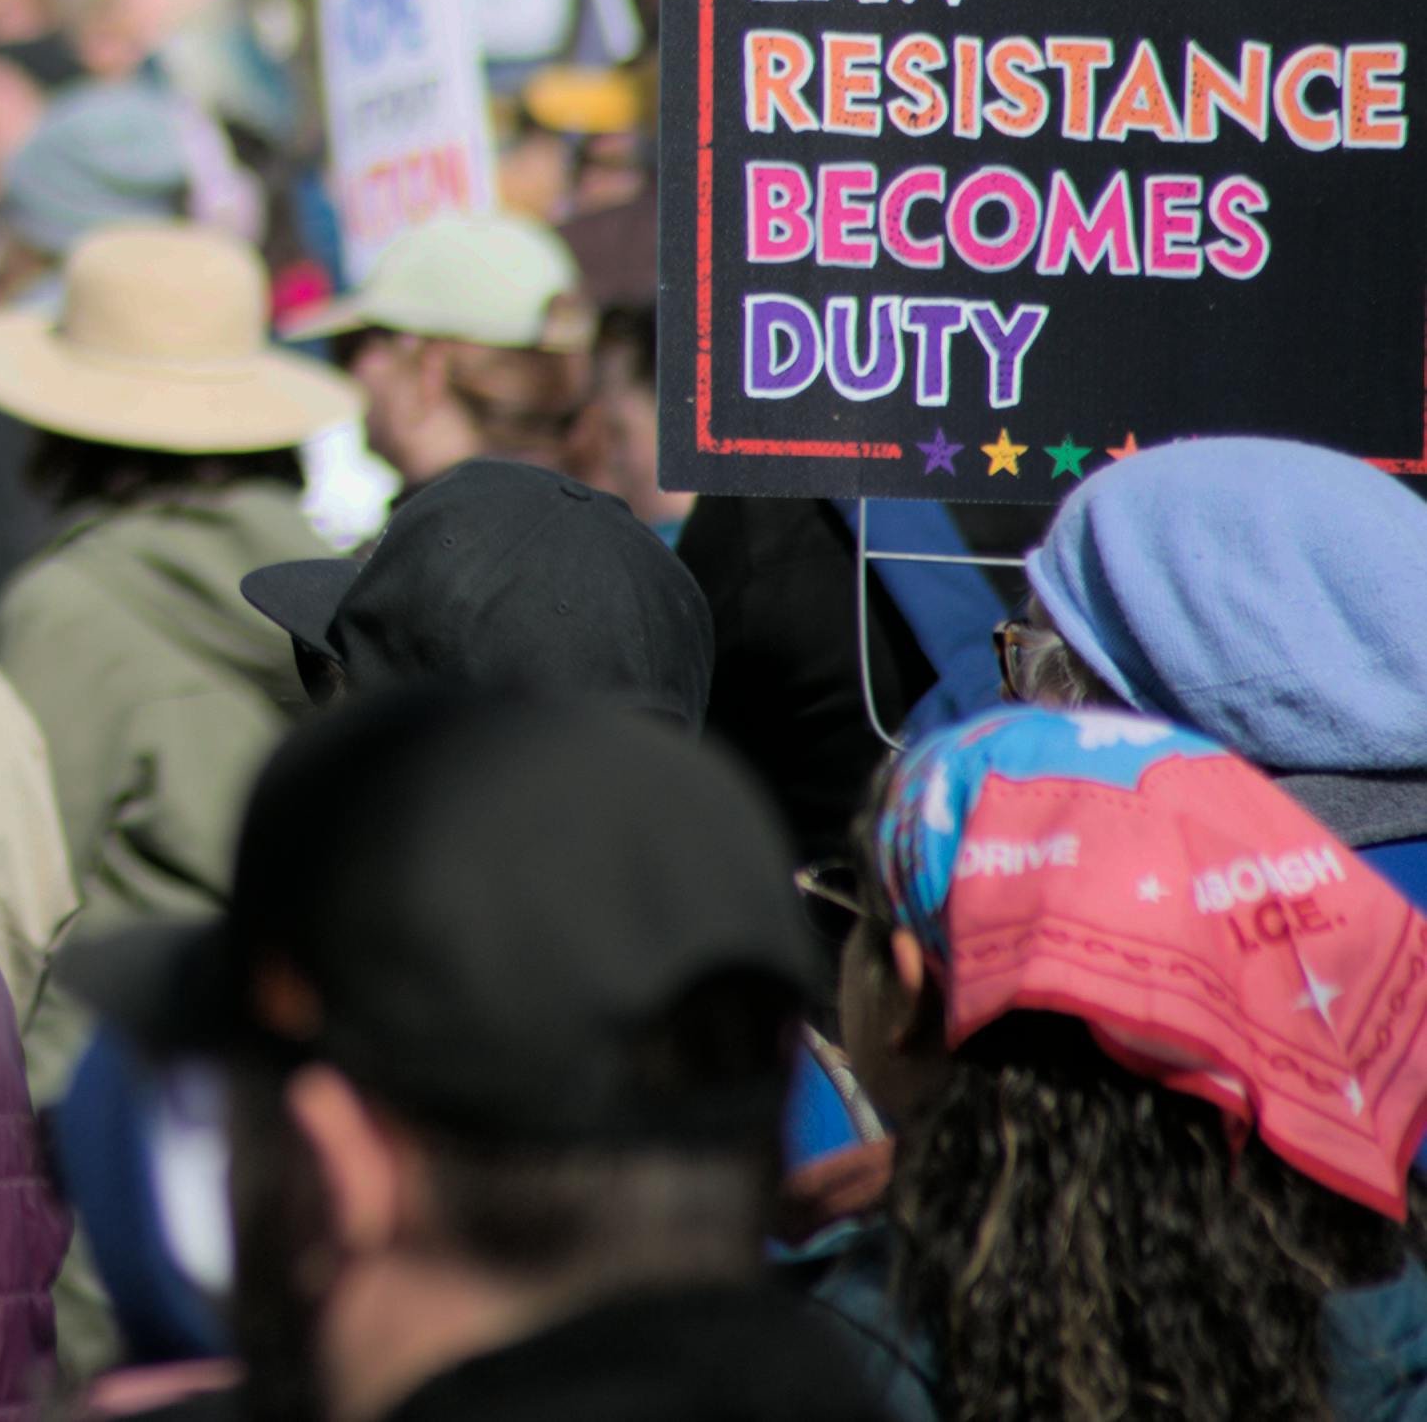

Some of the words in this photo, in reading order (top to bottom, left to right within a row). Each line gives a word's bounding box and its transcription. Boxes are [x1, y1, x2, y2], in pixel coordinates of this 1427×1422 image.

[741, 28, 1409, 152] RESISTANCE
[743, 158, 1271, 281] BECOMES
[741, 292, 1049, 409] DUTY
